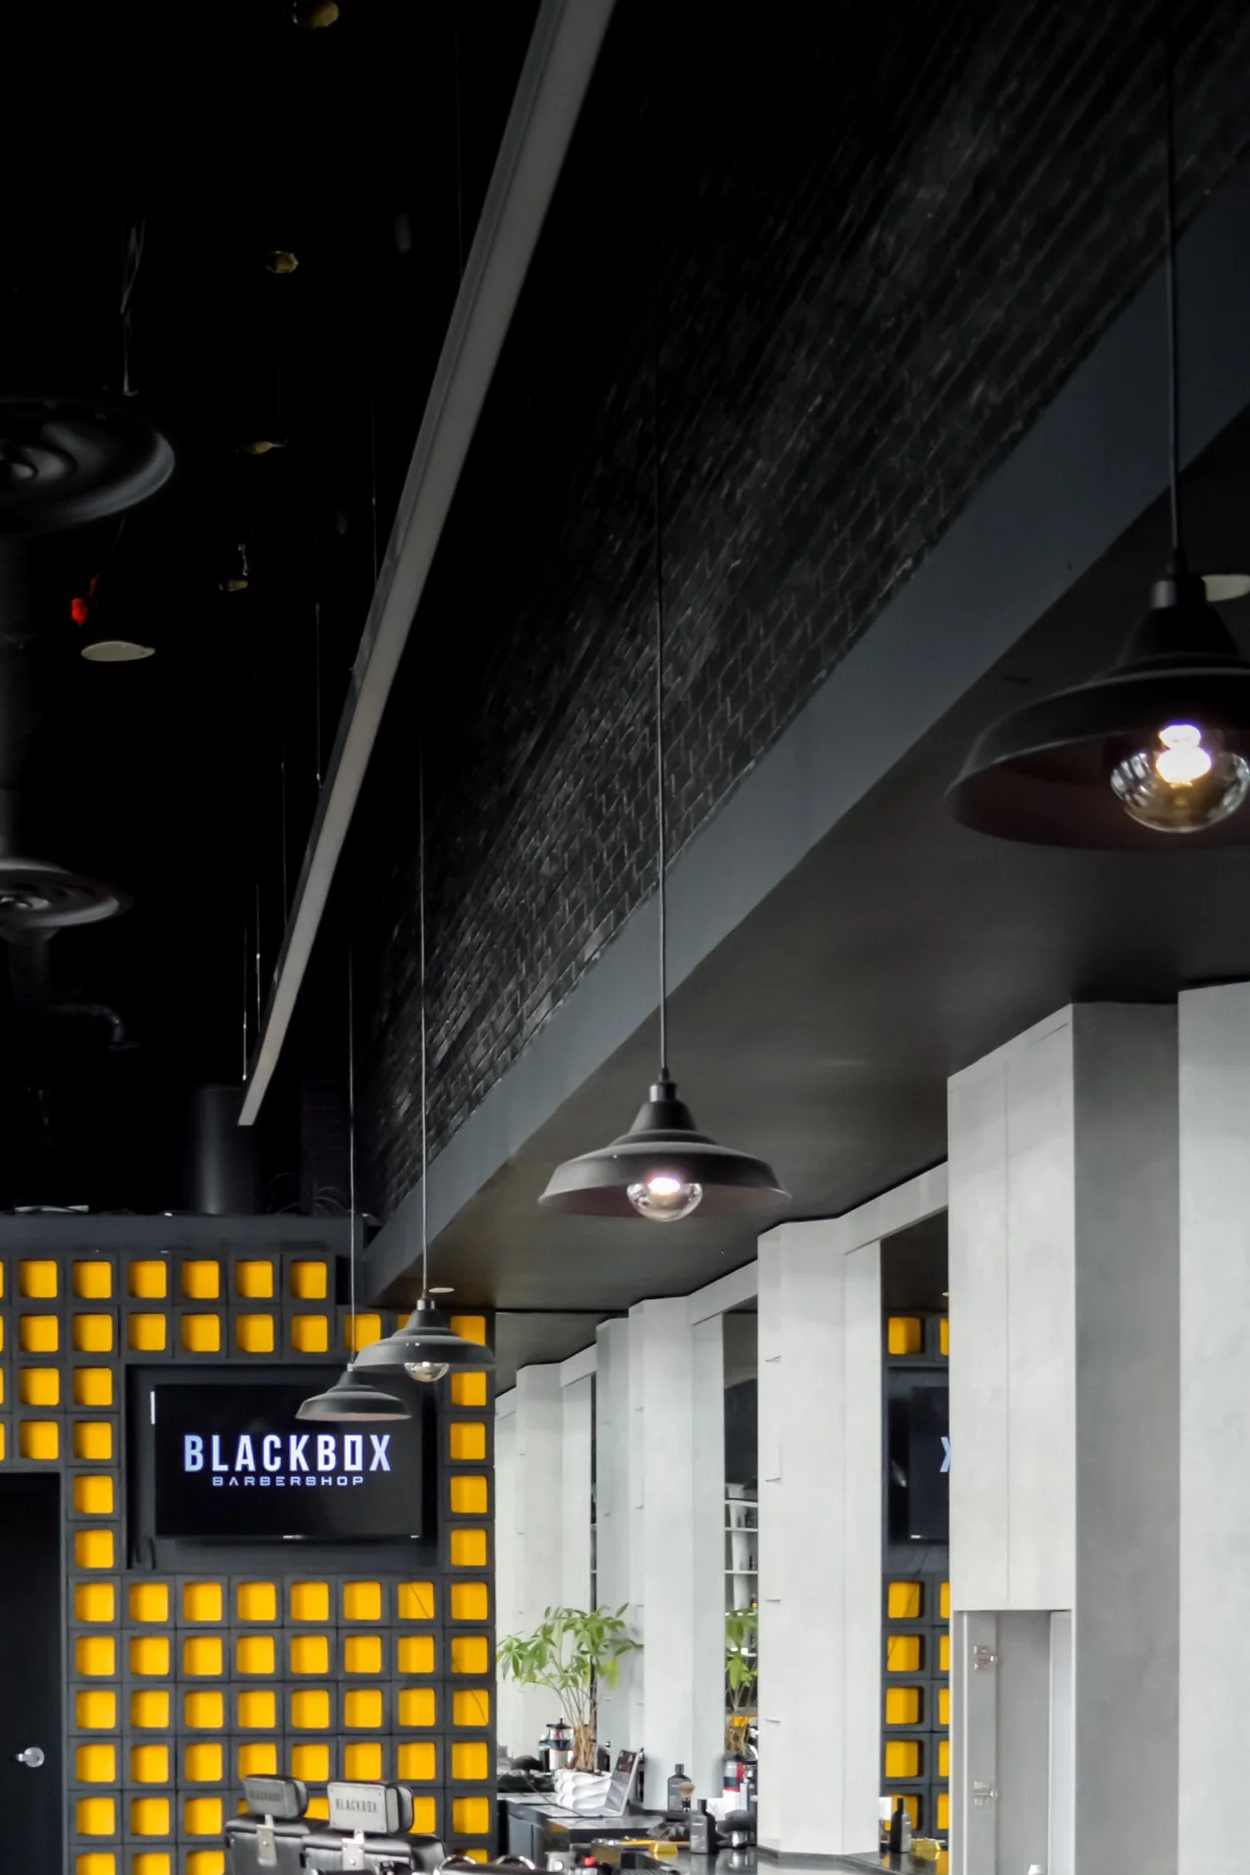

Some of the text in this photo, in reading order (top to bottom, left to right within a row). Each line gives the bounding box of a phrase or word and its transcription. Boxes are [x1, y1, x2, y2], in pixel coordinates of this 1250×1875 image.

[184, 1434, 391, 1472] BLACKBOX
[212, 1476, 364, 1486] BARBERSHOP
[336, 1798, 377, 1813] BLACKBOX
